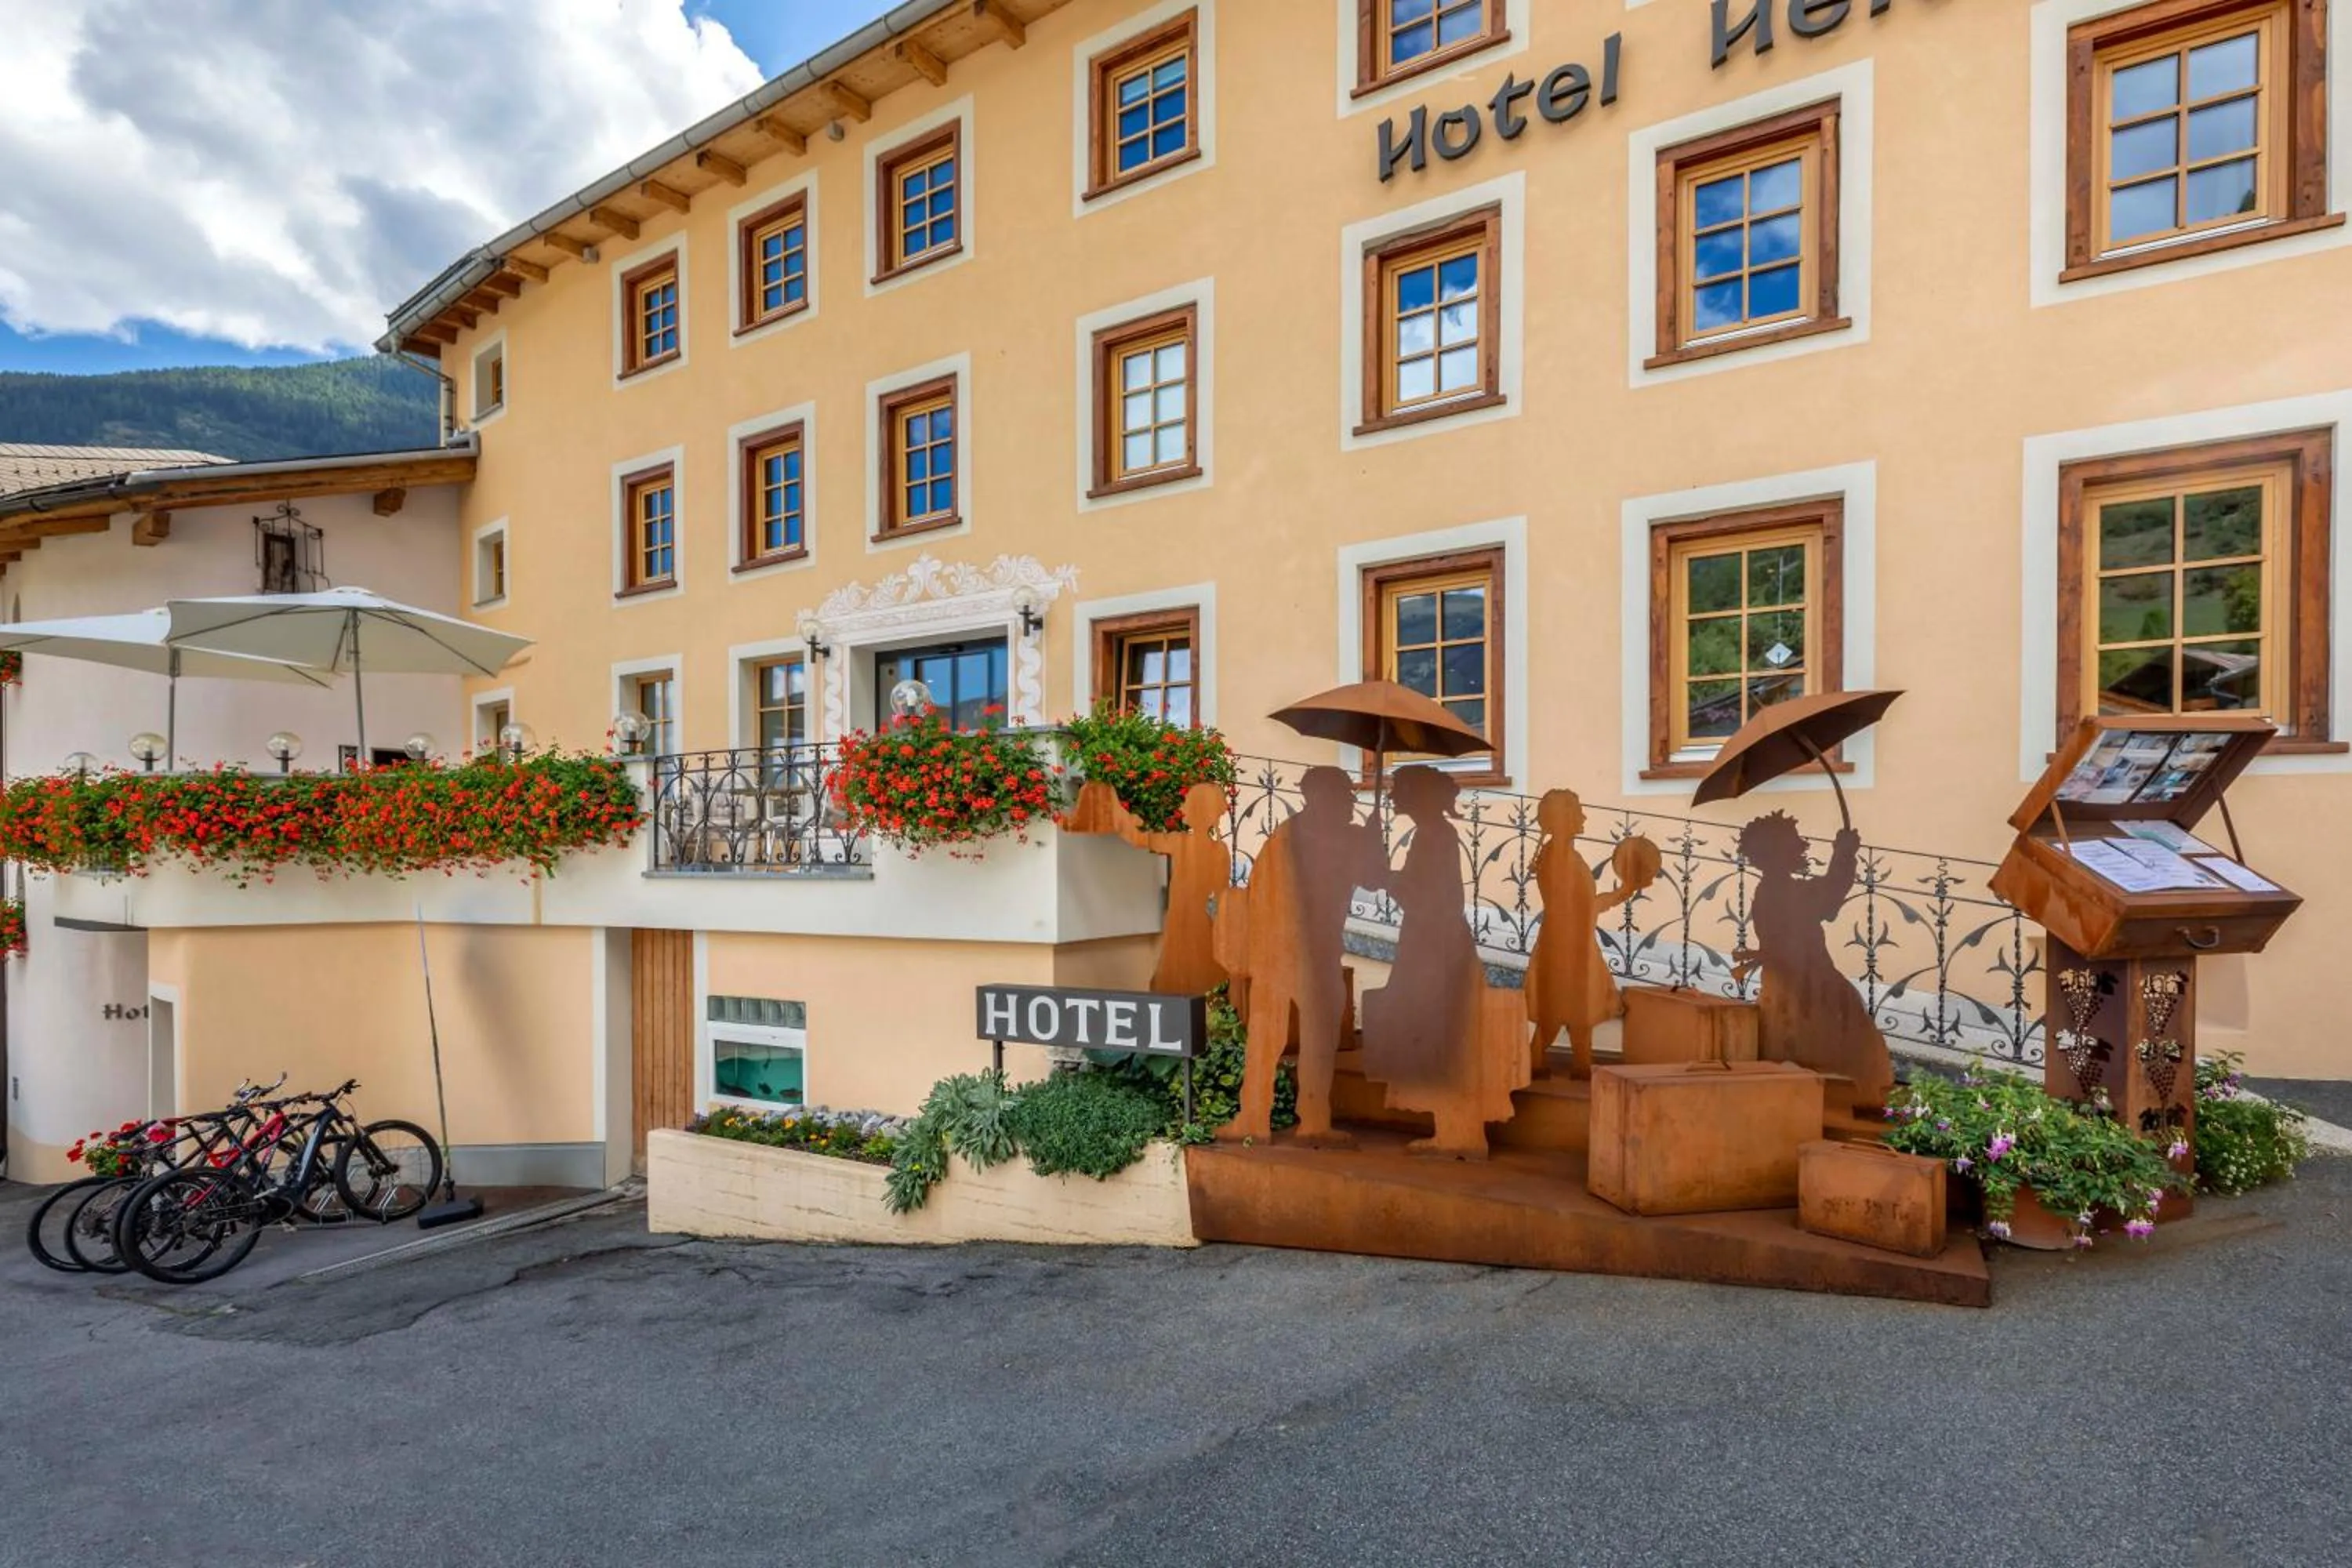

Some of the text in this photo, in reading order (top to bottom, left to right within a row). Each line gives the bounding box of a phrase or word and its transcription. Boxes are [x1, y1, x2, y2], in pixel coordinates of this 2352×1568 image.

[1377, 0, 1891, 183] Hotel He
[985, 992, 1182, 1051] HOTEL
